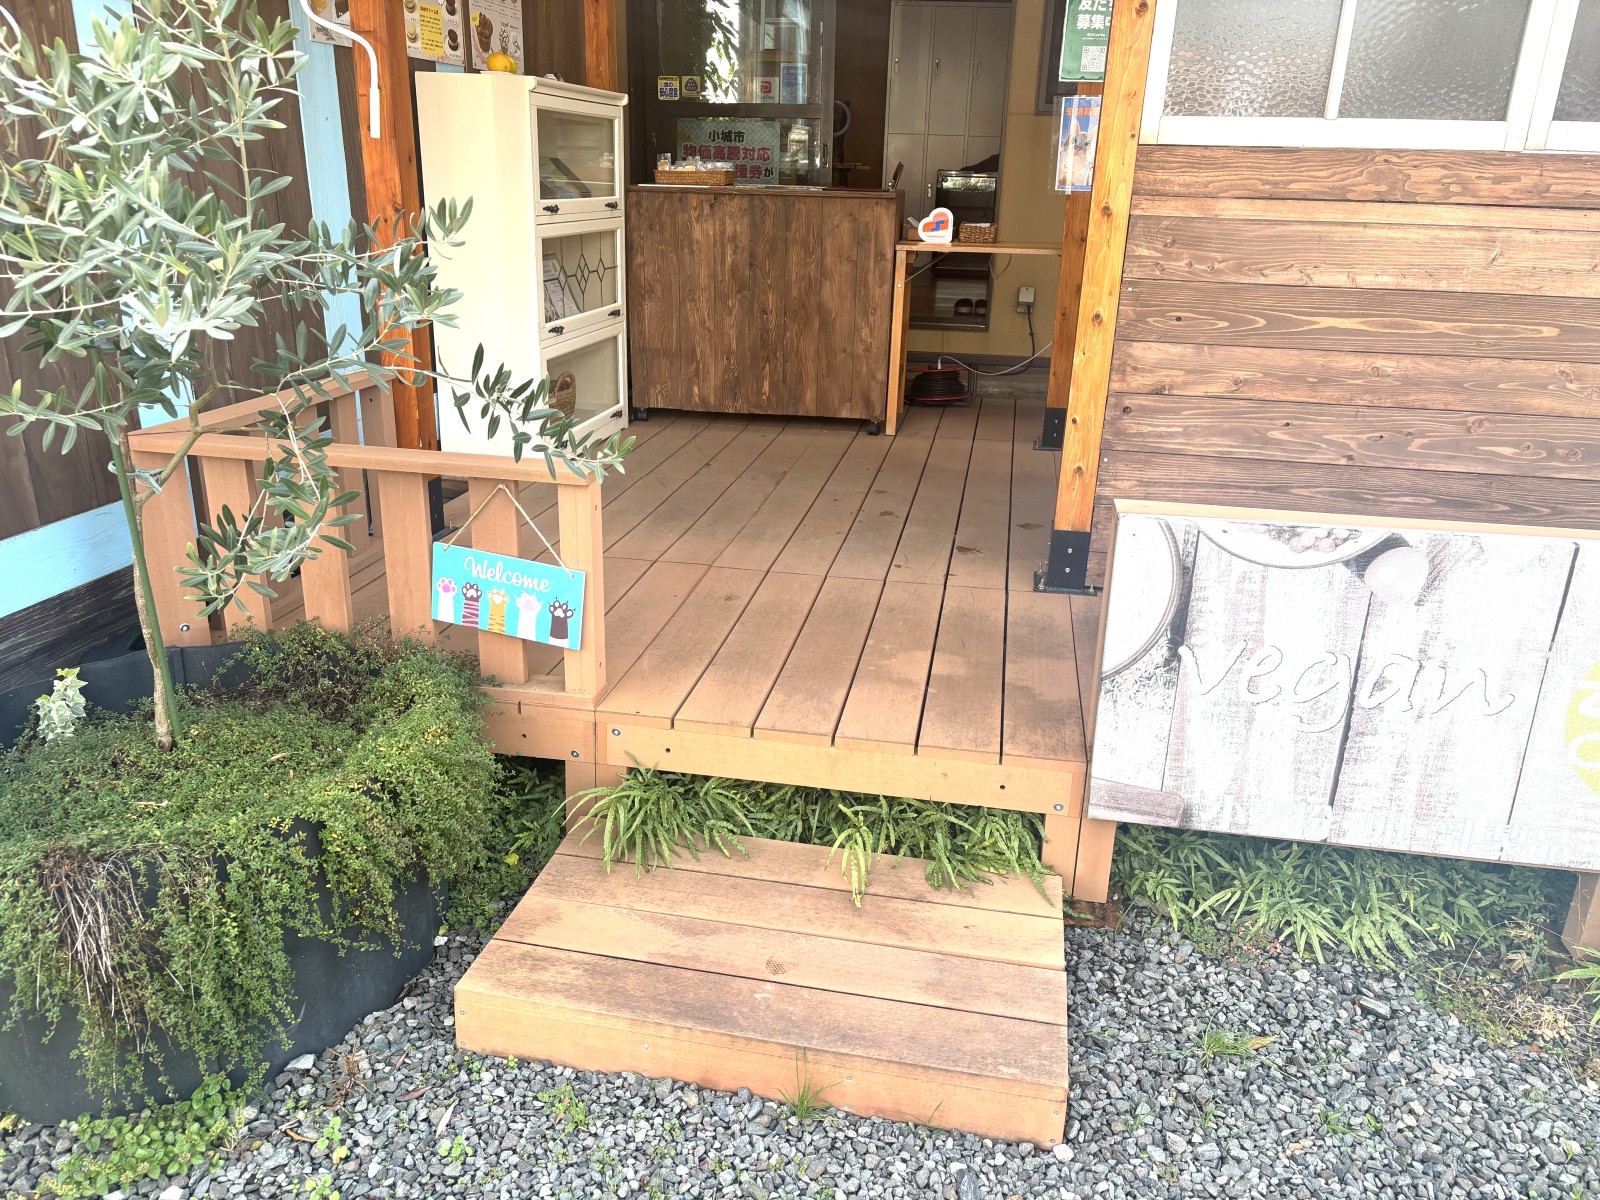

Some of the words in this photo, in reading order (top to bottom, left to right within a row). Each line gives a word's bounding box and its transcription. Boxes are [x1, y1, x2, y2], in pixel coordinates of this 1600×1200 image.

[708, 129, 746, 144] 小城市
[682, 143, 772, 162] 物価高騰対応
[464, 556, 551, 592] Welcome
